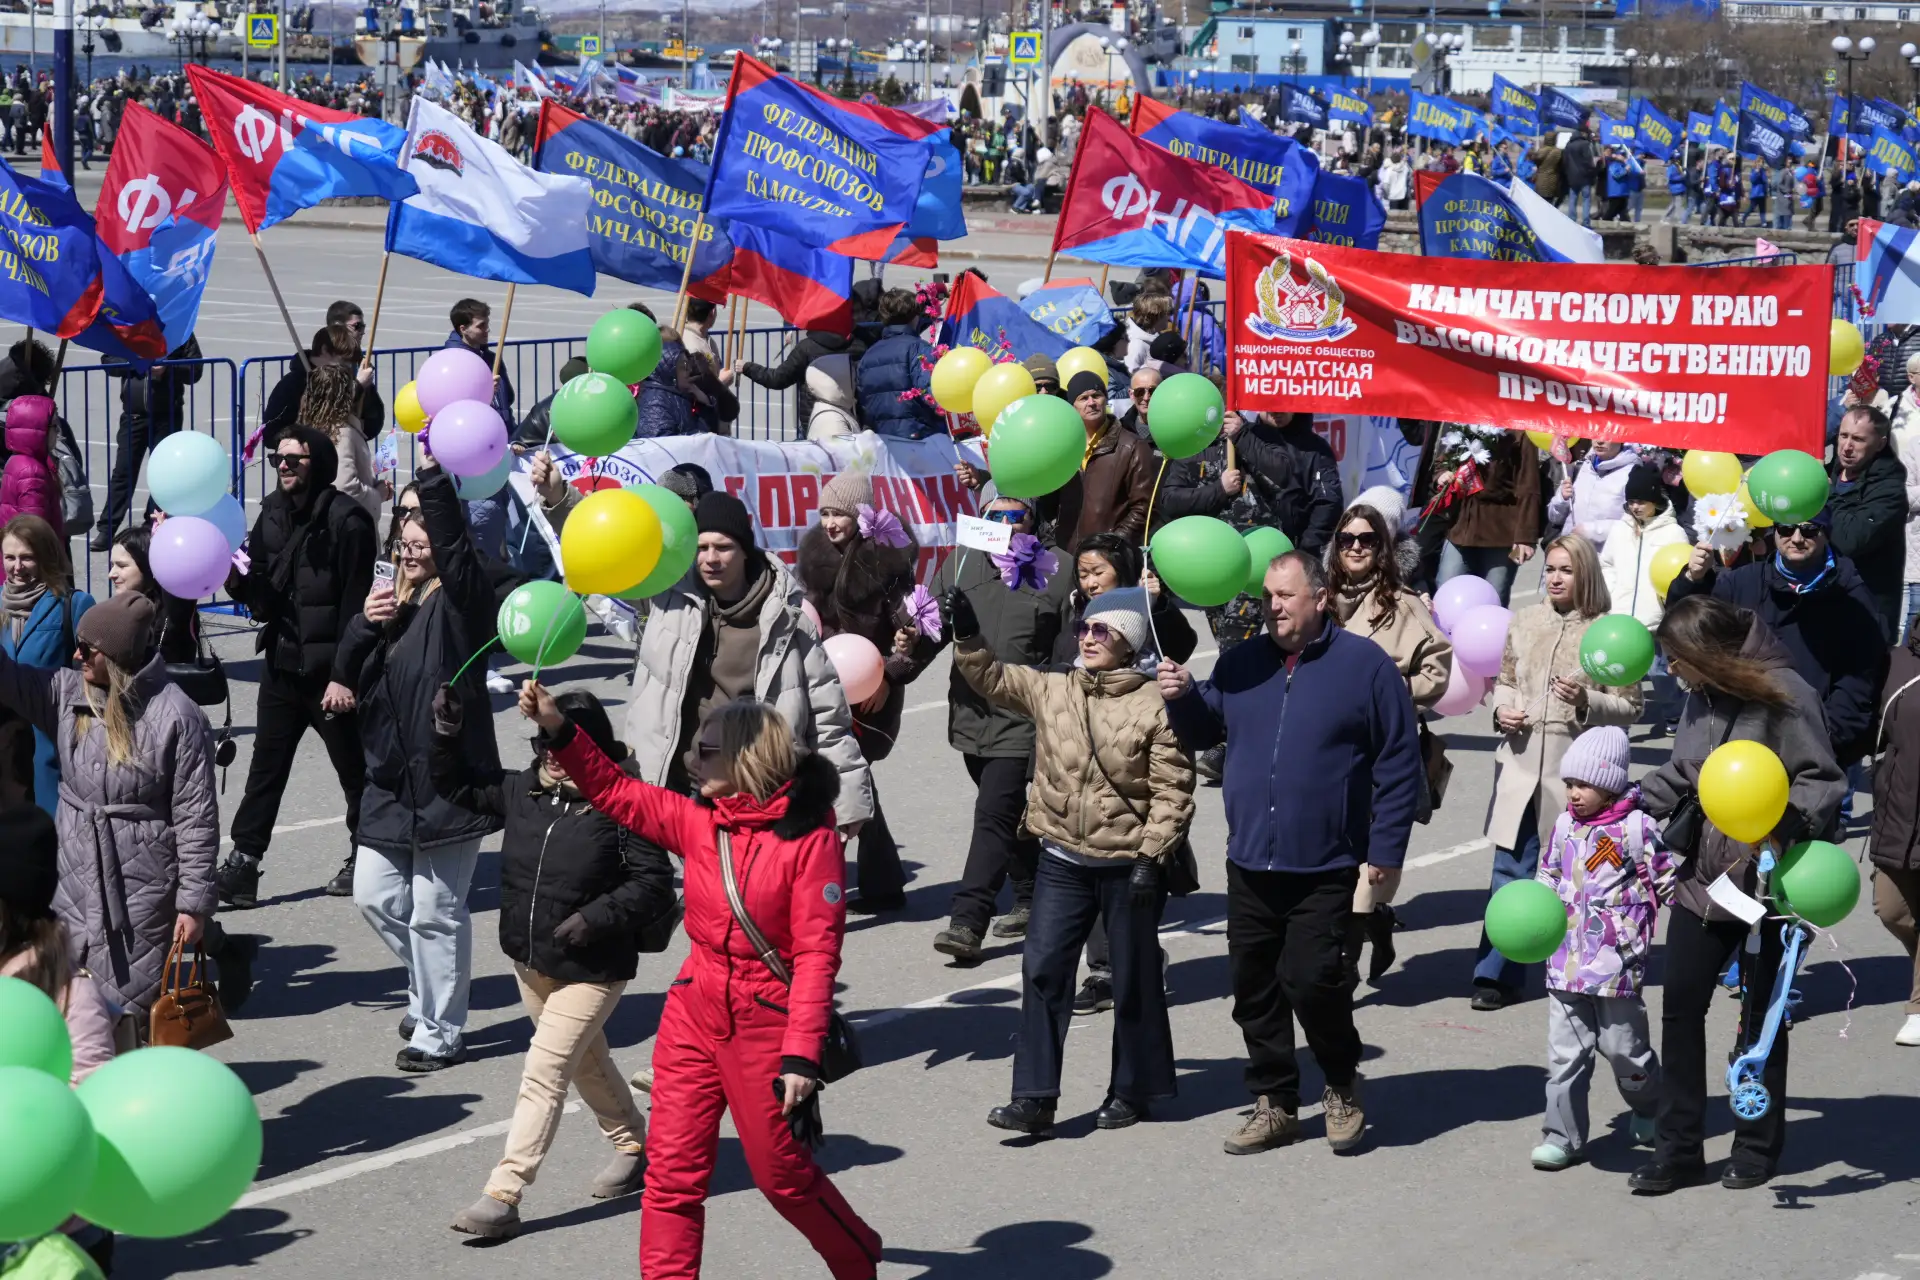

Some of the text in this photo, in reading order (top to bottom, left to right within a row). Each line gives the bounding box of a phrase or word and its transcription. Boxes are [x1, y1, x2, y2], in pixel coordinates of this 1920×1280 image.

[763, 103, 878, 177] ФЕДЕРАЦИЯ
[565, 151, 704, 211] ФЕДЕРАЦИЯ
[742, 130, 885, 212] ПРОФСОЮЗОВ
[585, 215, 690, 264] МЧАТКИ
[588, 186, 714, 242] ФСОЮЗОВ
[1407, 283, 1681, 326] КАМЧАТСКОМУ
[1691, 294, 1778, 327] КРАЮ
[1234, 344, 1375, 358] АКЦИОНЕРНОЕ ОБЩЕСТВО
[1235, 358, 1373, 380] КАМЧАТСКАЯ
[1395, 319, 1811, 377] ВЫСОКОКАЧЕСТВЕННУЮ
[1244, 377, 1363, 400] МЕЛЬНИЦА
[1498, 372, 1728, 425] ПРОДУКЦИЮ!
